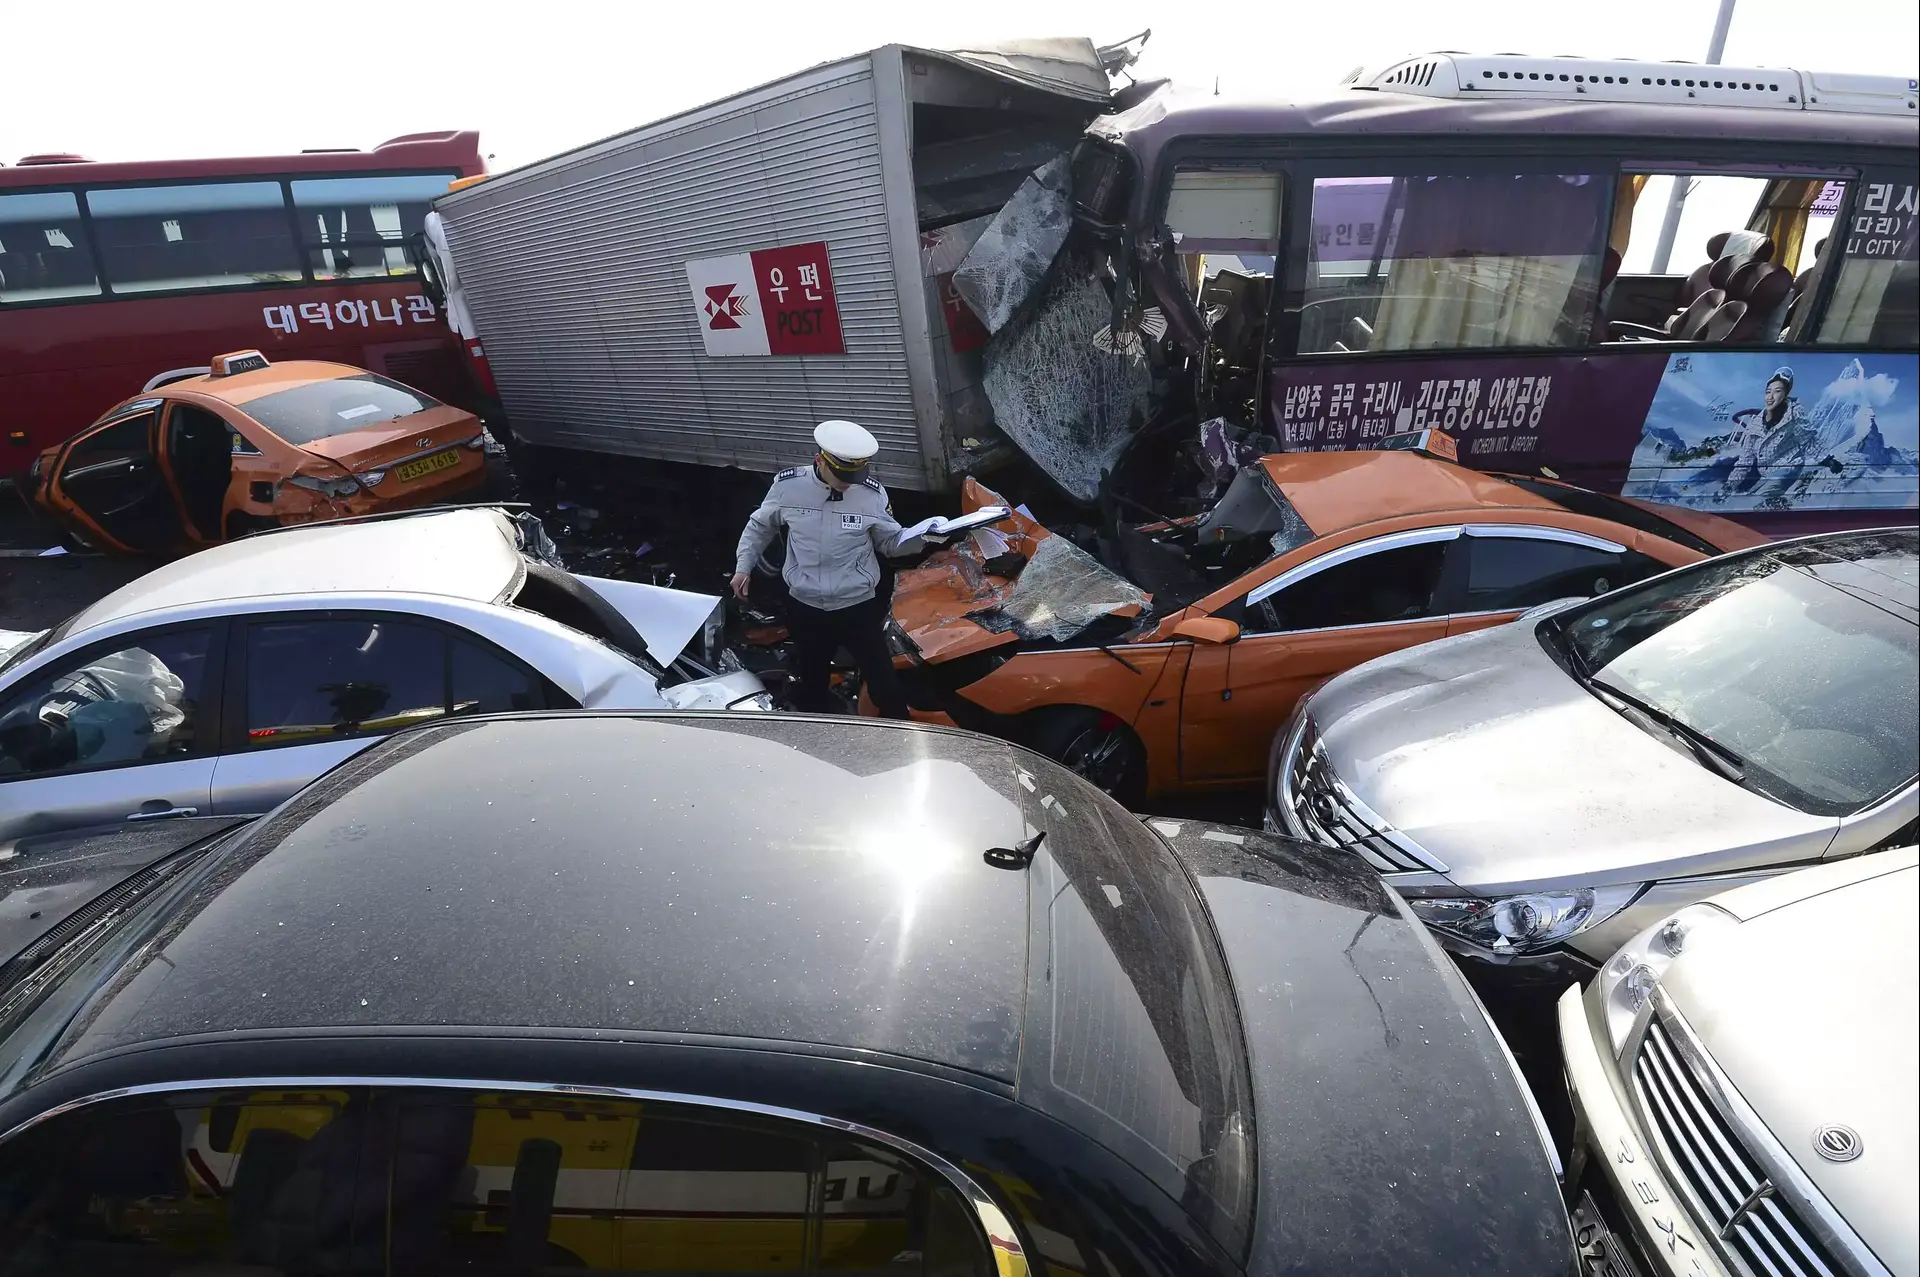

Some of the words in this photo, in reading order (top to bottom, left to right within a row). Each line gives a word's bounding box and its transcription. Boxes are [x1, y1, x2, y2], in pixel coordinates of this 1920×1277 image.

[1866, 238, 1901, 255] CITY
[263, 295, 449, 334] 대덕하나관
[777, 307, 824, 337] POST
[237, 359, 257, 370] TAXI
[1284, 385, 1322, 419] 남양주
[1329, 383, 1355, 417] 금곡
[1362, 381, 1401, 415] 구리시
[1509, 435, 1538, 452] AIRPORT
